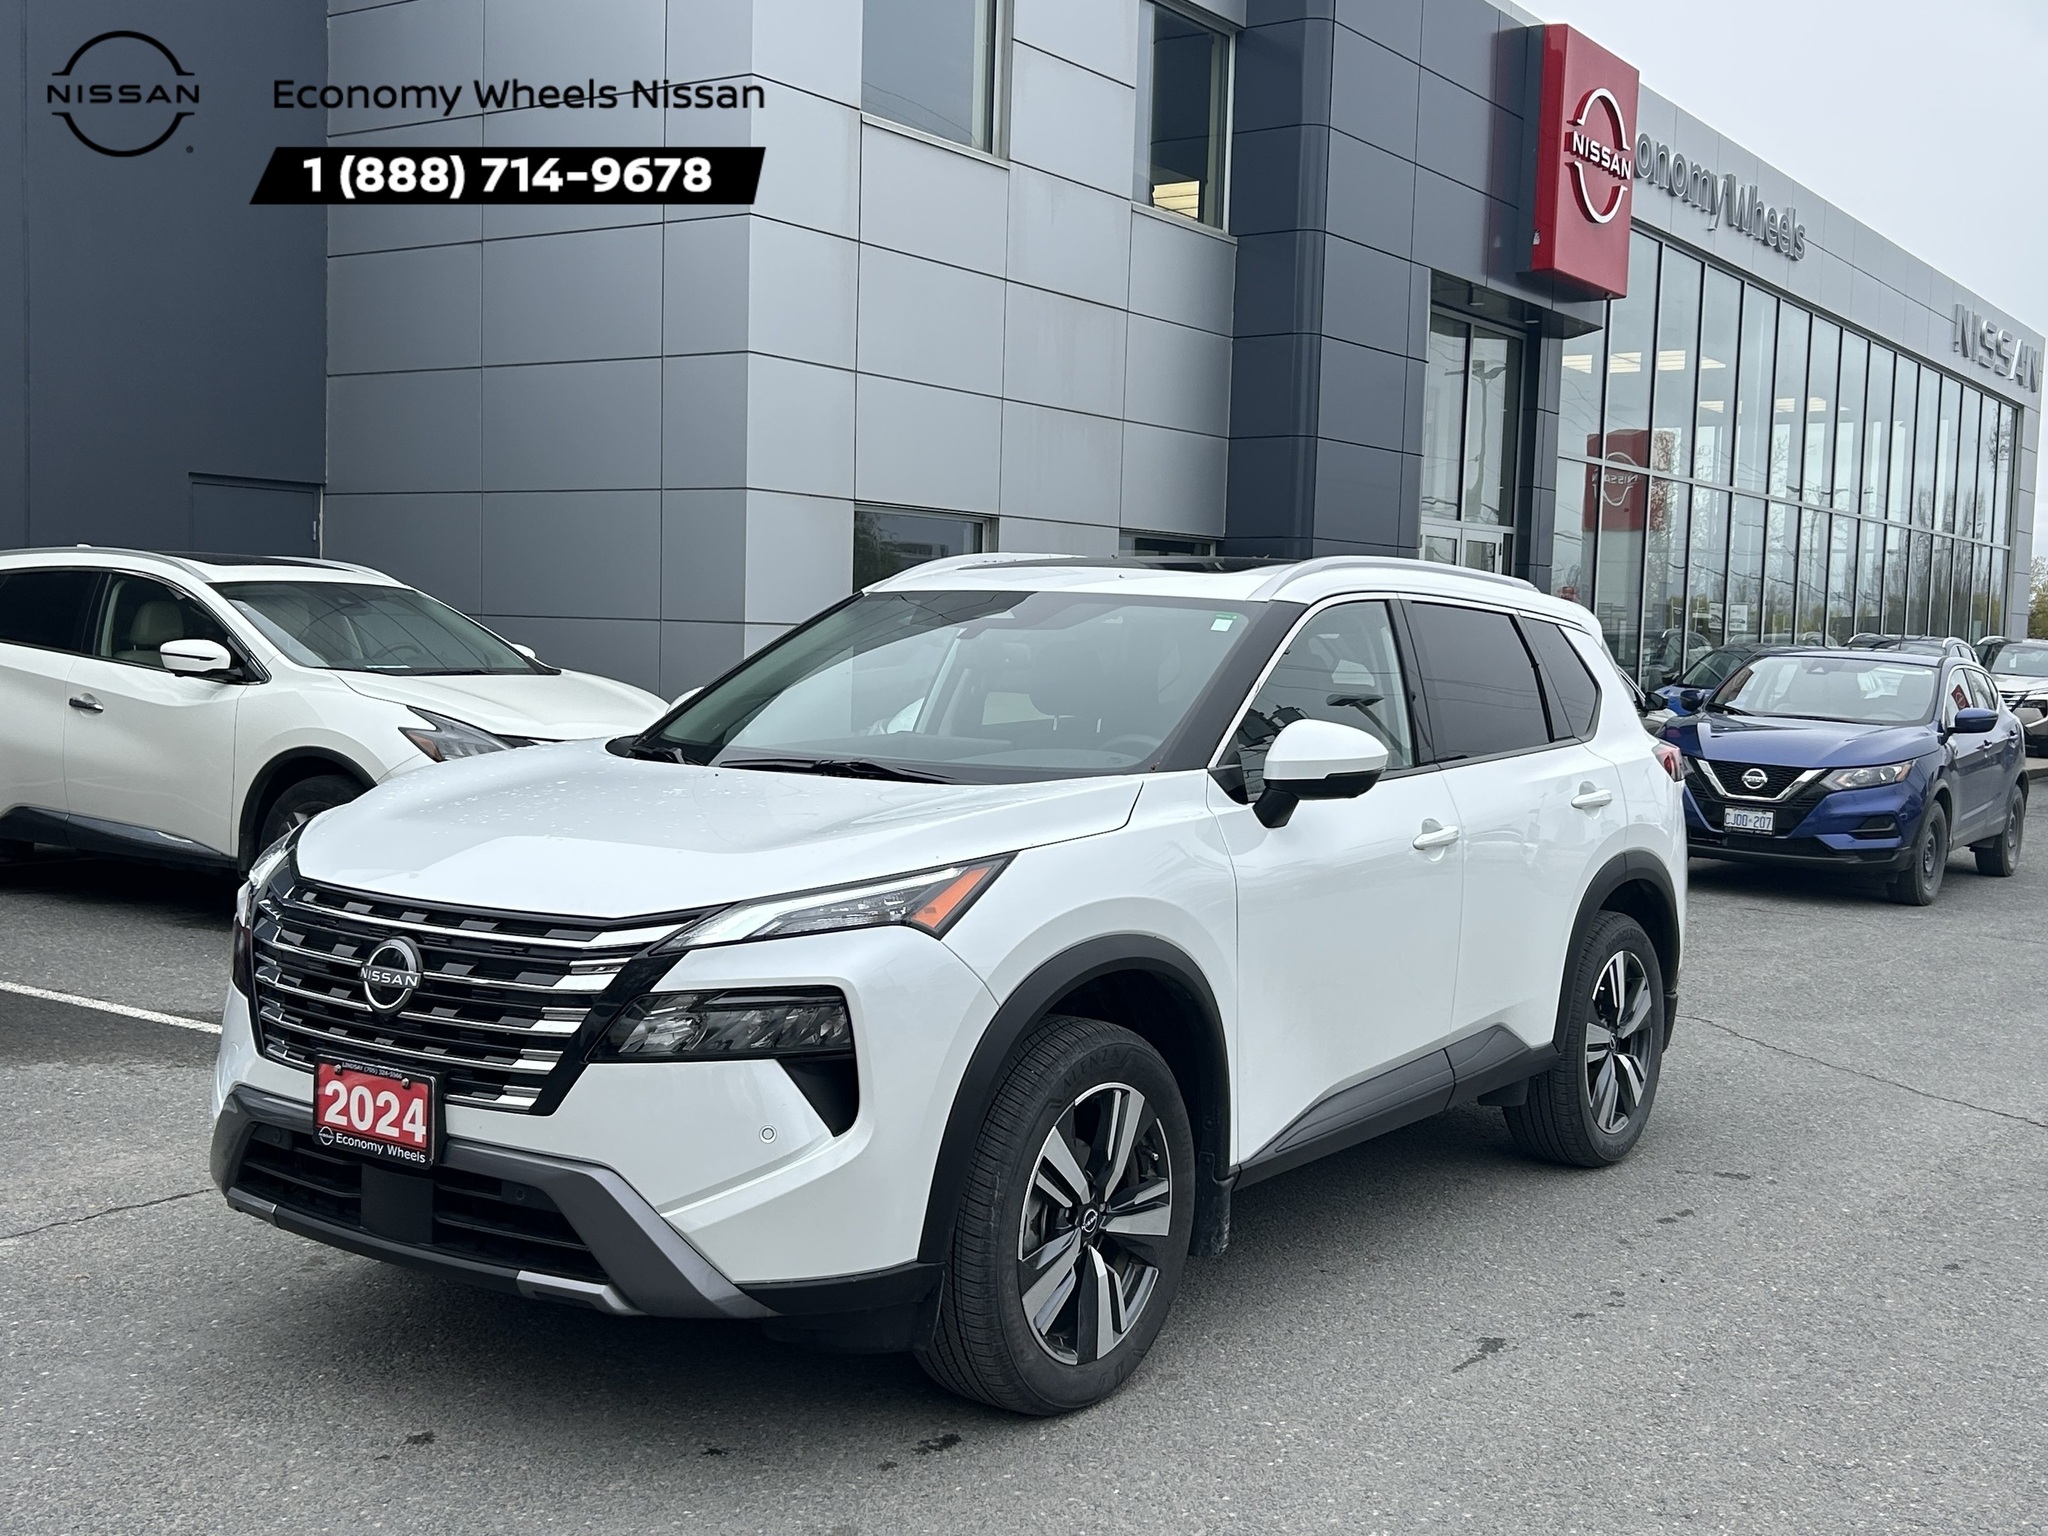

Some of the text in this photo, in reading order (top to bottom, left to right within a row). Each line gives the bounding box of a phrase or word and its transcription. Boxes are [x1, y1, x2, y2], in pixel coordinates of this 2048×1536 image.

[1571, 130, 1632, 181] NISSAN
[1635, 133, 1806, 261] onomy Wheels
[1953, 304, 2042, 393] NISSAN
[1753, 815, 1772, 829] 207
[361, 967, 418, 987] NISSAN
[324, 1080, 427, 1143] 2024
[336, 1132, 426, 1163] Economy Wheels
